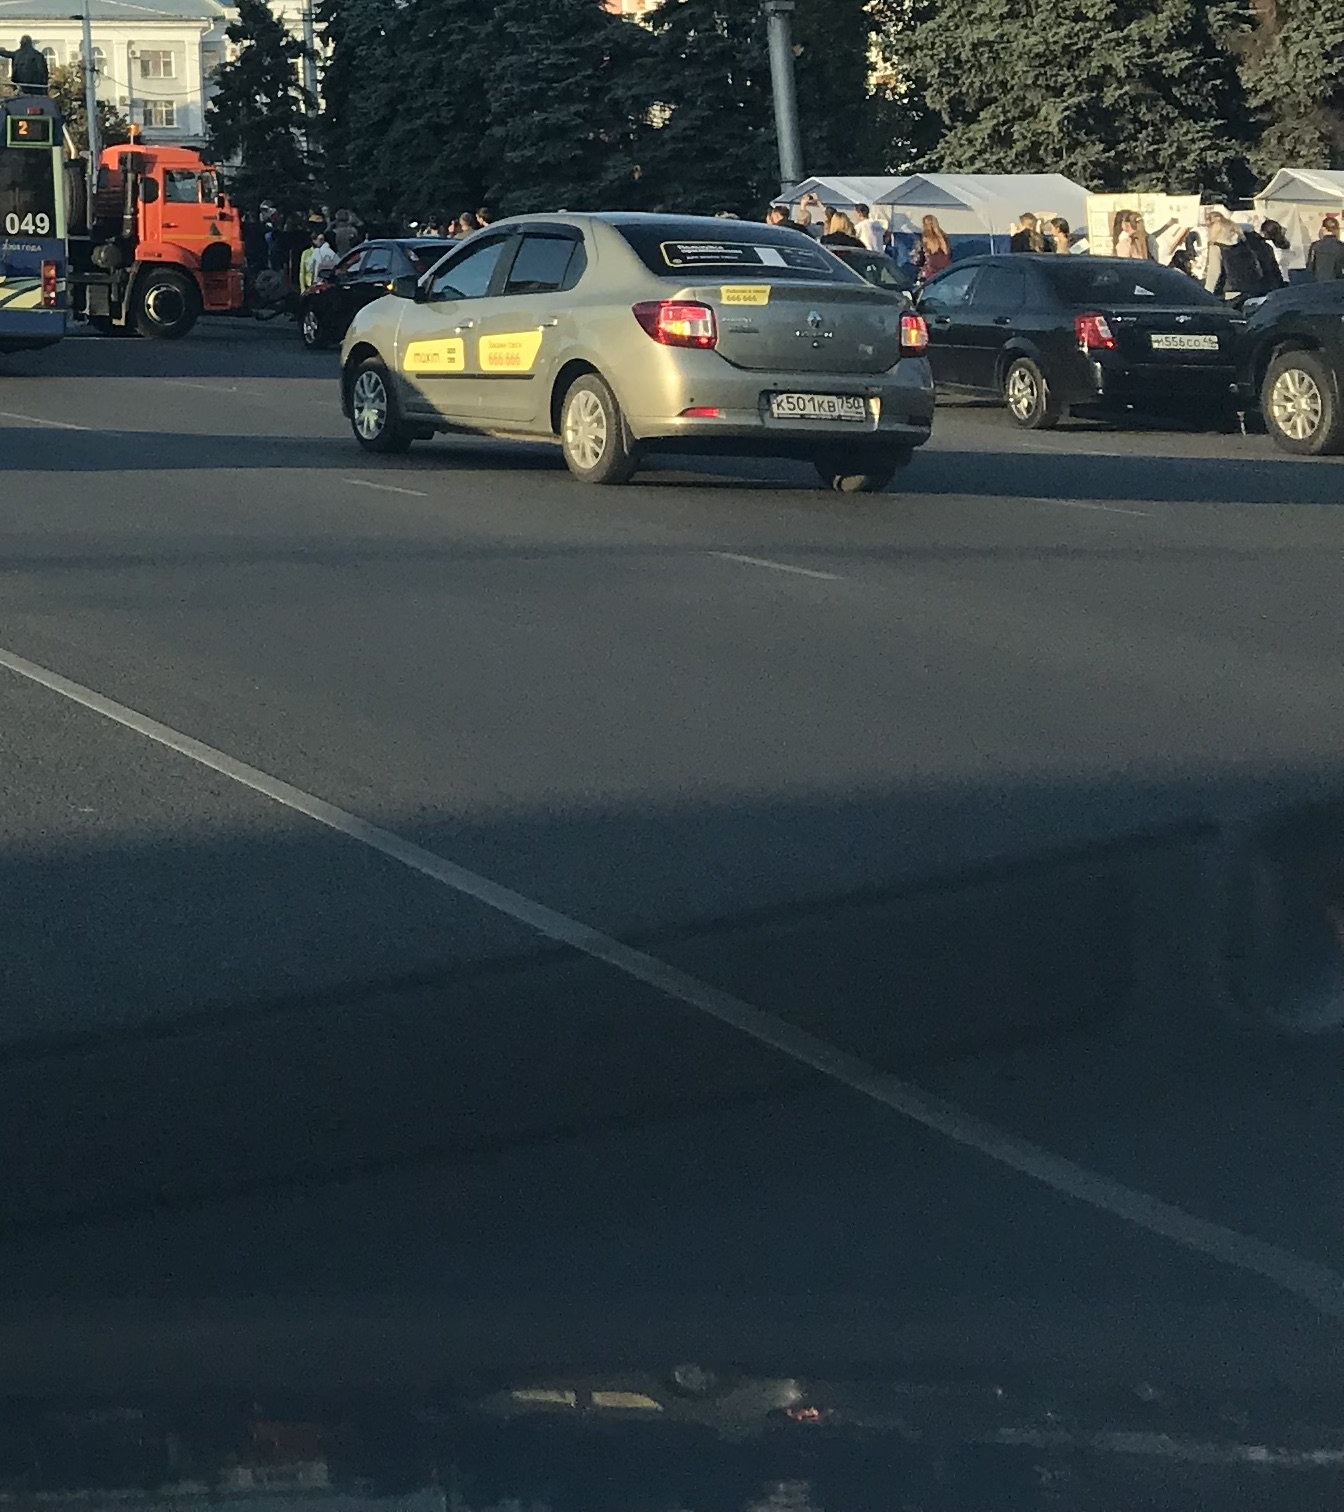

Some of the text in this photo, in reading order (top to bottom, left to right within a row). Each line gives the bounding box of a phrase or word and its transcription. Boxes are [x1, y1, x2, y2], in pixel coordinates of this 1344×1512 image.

[18, 120, 28, 135] 2
[5, 212, 50, 235] 049
[776, 395, 837, 413] К501КВ
